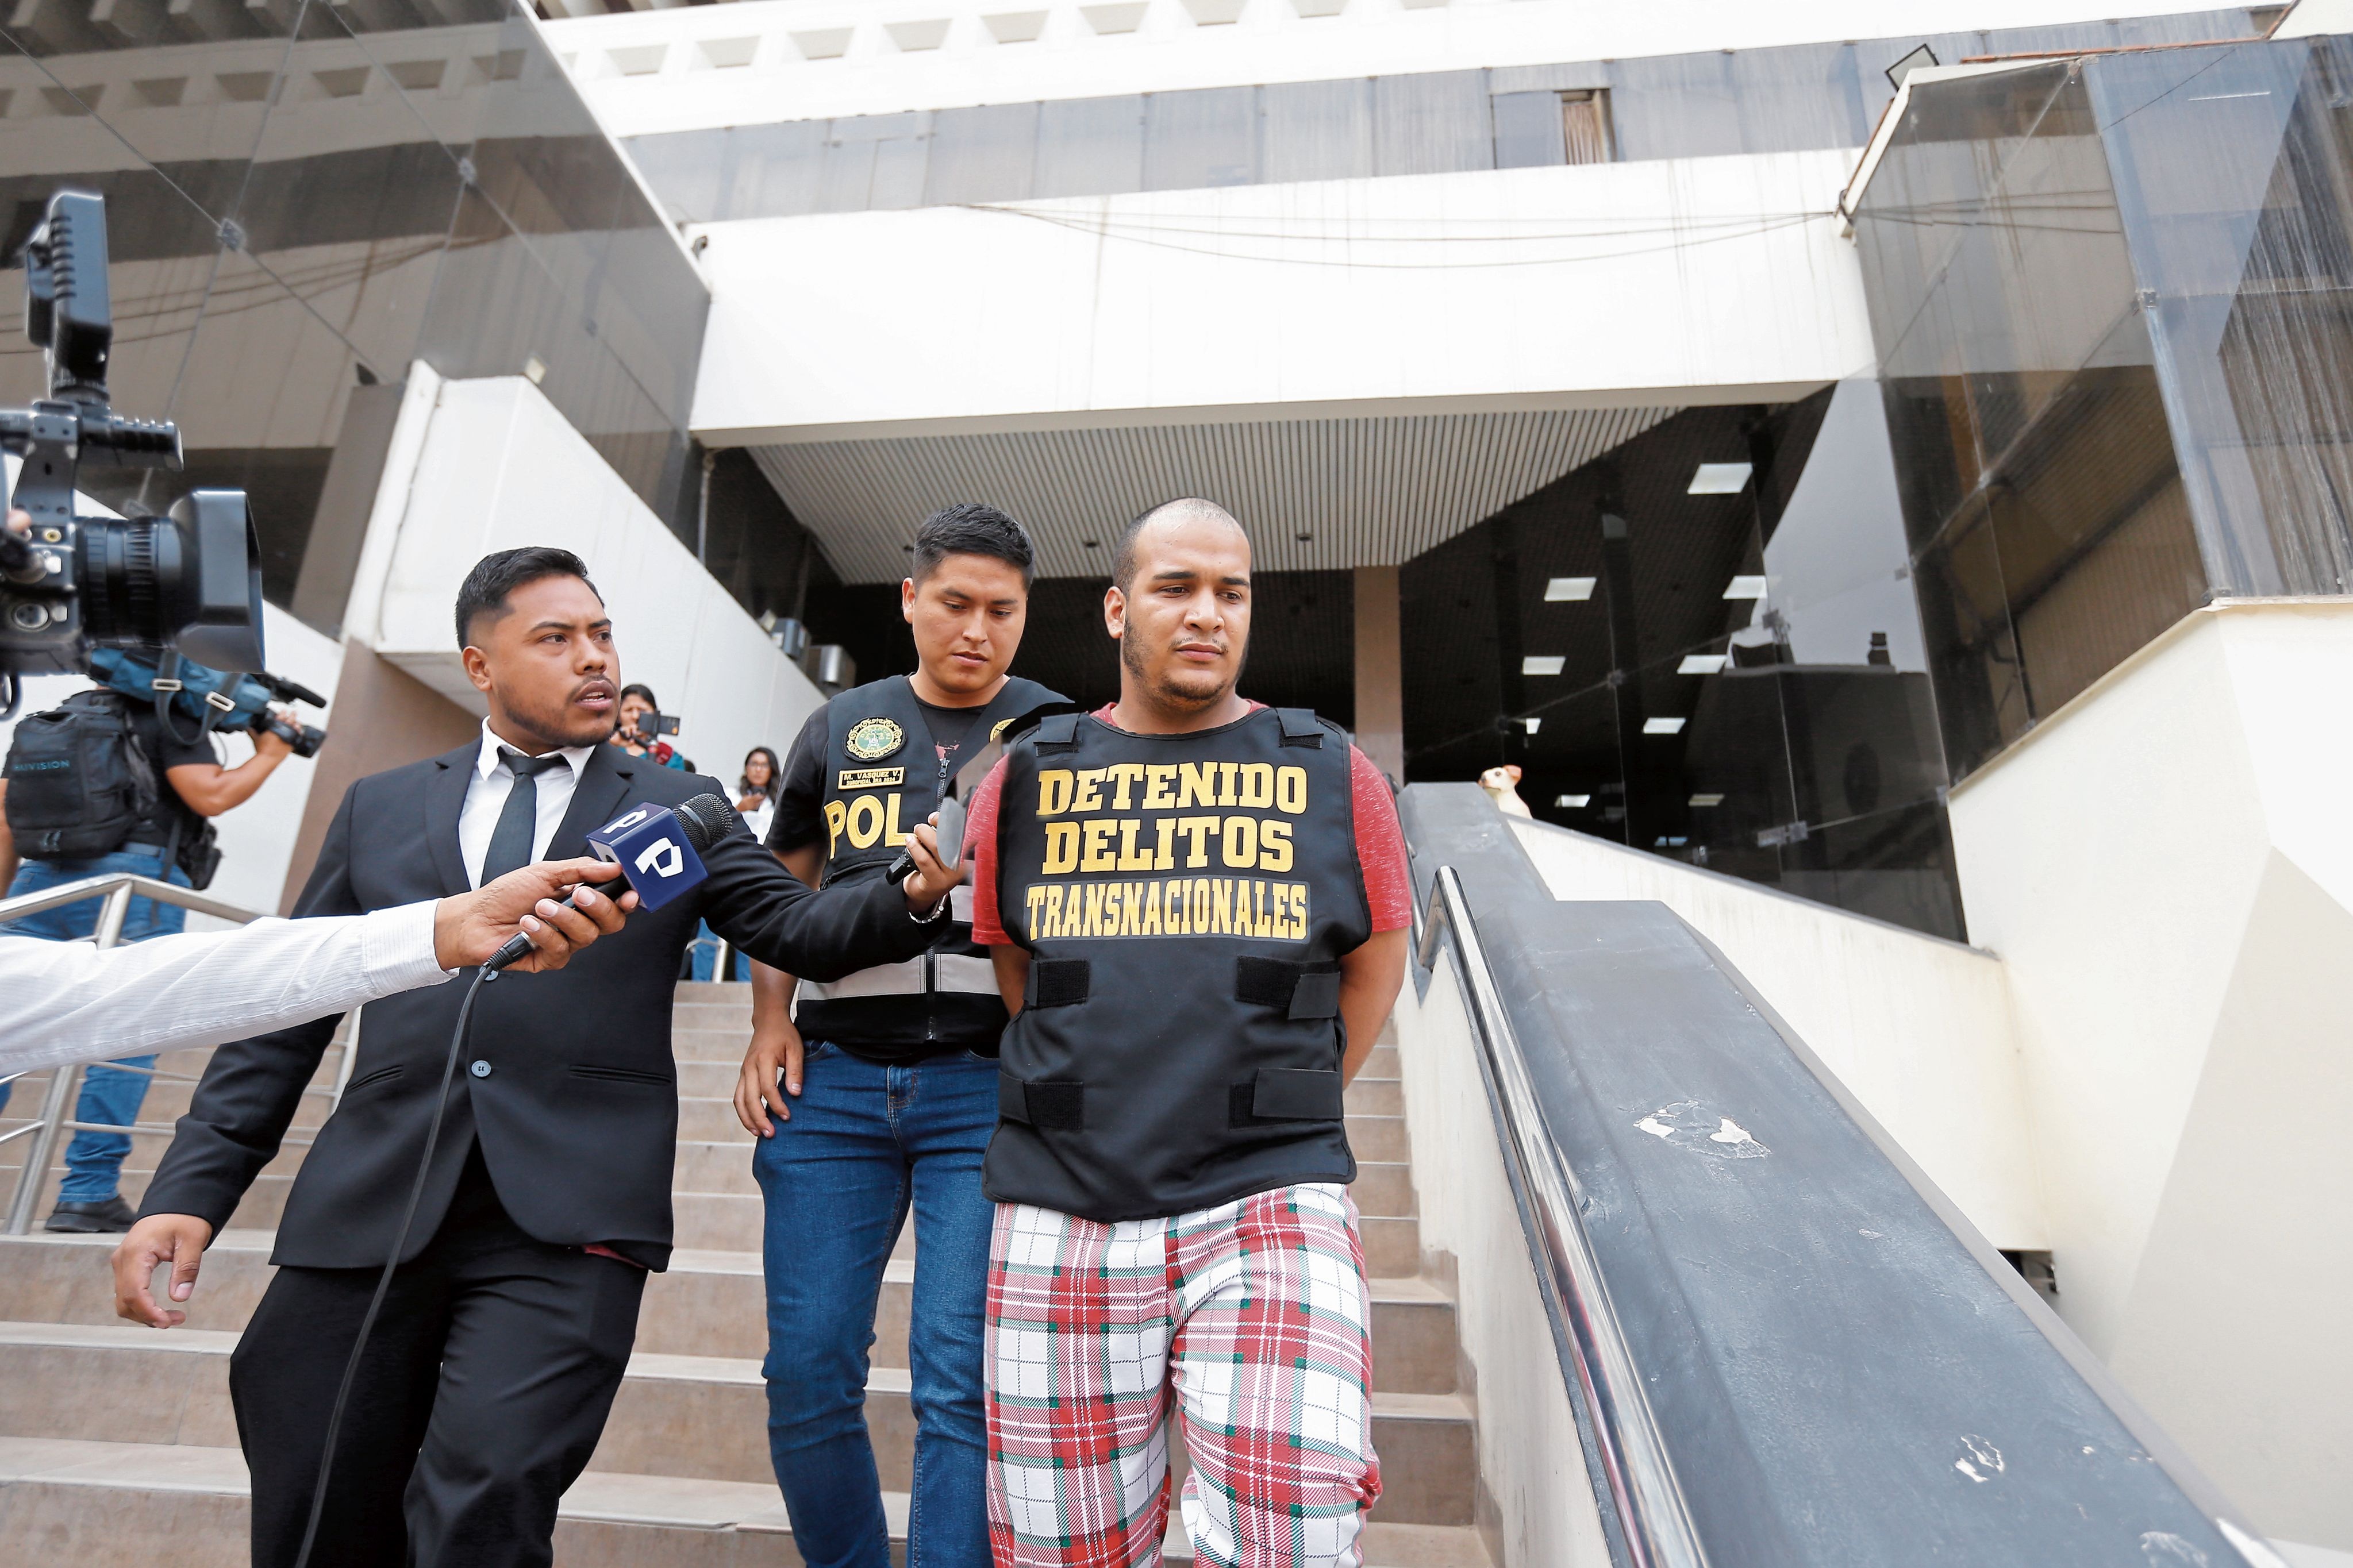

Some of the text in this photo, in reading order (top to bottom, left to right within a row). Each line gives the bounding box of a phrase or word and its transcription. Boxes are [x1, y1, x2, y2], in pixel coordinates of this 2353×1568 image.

[857, 771, 889, 779] VASQUEZ
[1036, 761, 1308, 816] DETENIDO
[824, 793, 918, 860] POL
[1041, 815, 1294, 875] DELITOS
[1026, 877, 1307, 942] TRANSNACIONALES
